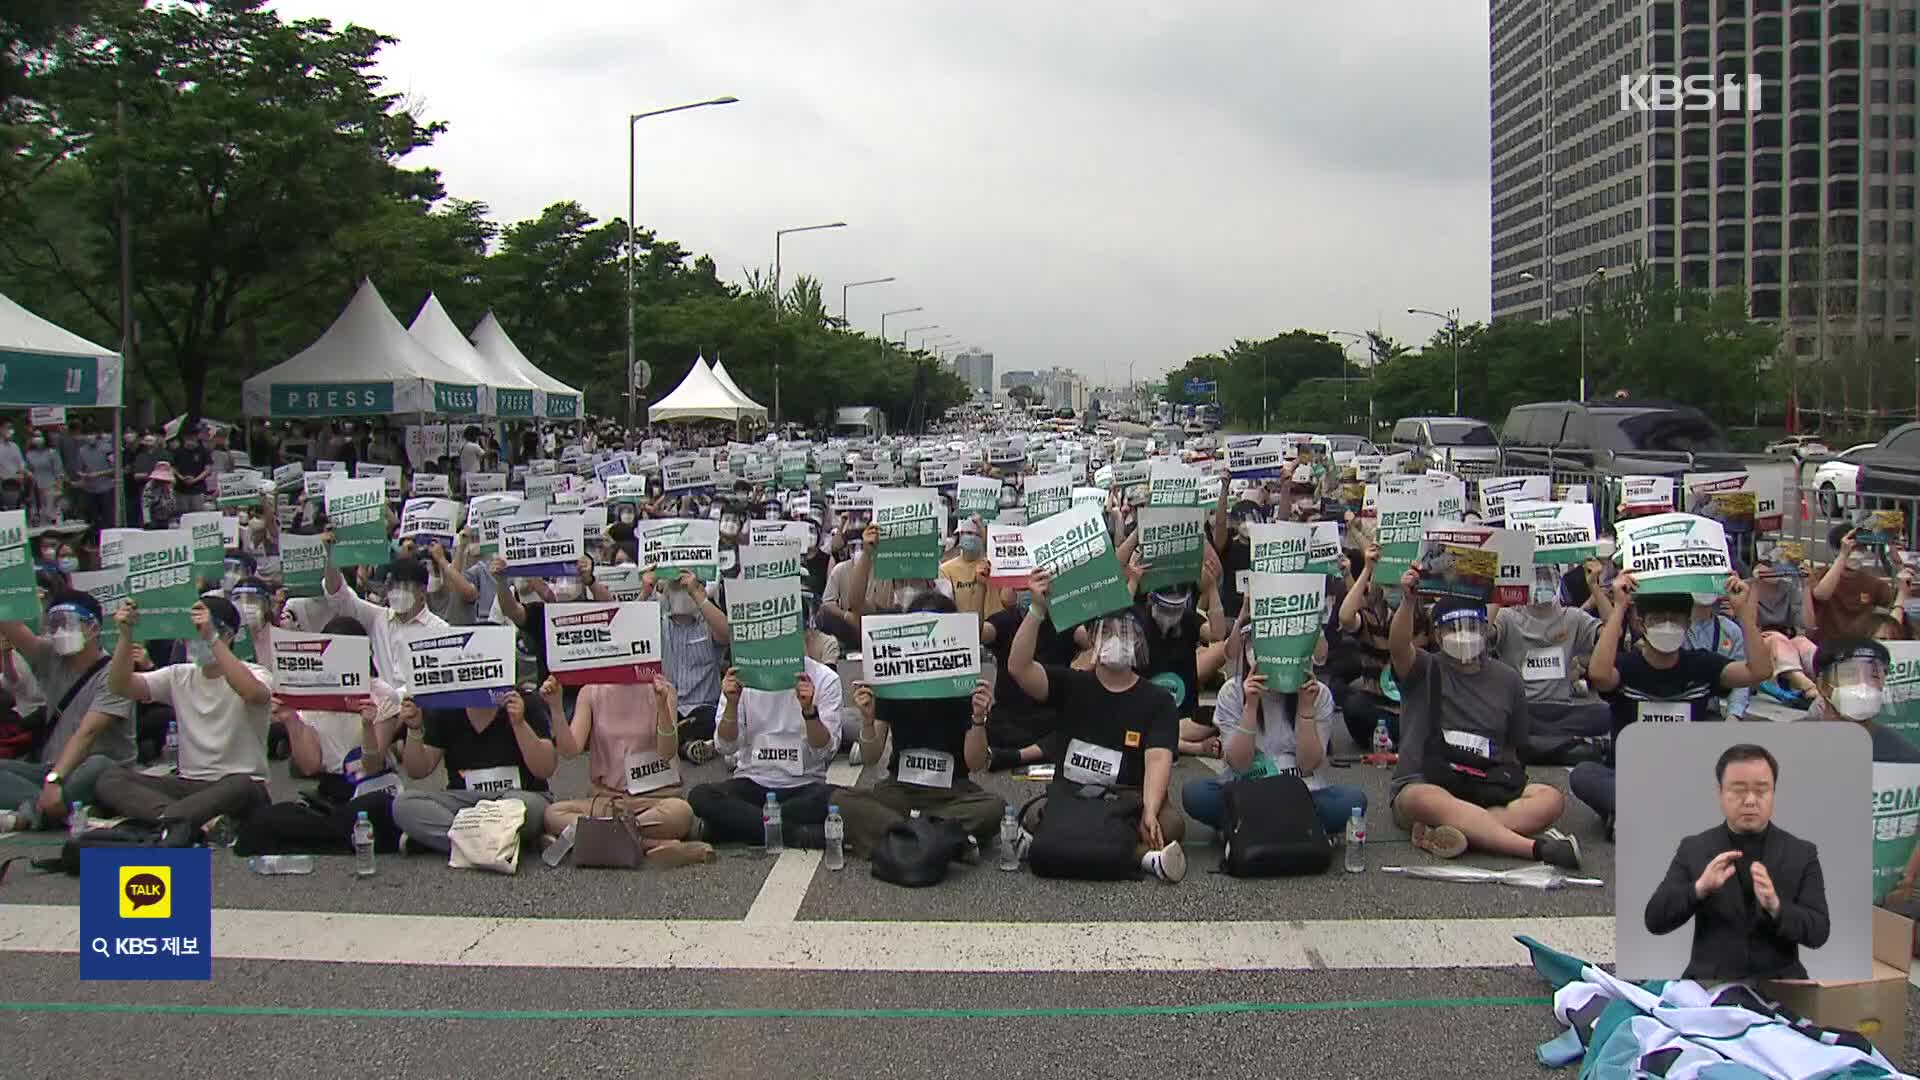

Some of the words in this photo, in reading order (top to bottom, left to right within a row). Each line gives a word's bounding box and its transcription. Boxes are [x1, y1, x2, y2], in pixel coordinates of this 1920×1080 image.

[288, 390, 376, 408] PRESS
[440, 391, 473, 407] PRESS
[501, 395, 529, 411] PRESS
[1152, 478, 1196, 490] 젊은의사
[1151, 489, 1196, 504] 단체행동
[877, 503, 933, 520] 젊은의사
[1143, 521, 1199, 541] 젊은의사
[505, 537, 526, 548] 나는
[644, 540, 661, 552] 나는
[1033, 517, 1100, 563] 젊은의사
[1143, 538, 1200, 559] 단체행동
[1255, 537, 1306, 558] 젊은의사
[505, 548, 537, 560] 의료를
[540, 544, 575, 557] 원한다!
[670, 548, 712, 561] 되고싶다!
[995, 545, 1028, 557] 전공의
[1632, 542, 1660, 557] 나는
[128, 546, 188, 572] 젊은의사
[1254, 555, 1306, 574] 단체행동
[1633, 555, 1672, 572] 의사가
[1675, 553, 1728, 568] 되고싶다!
[743, 558, 796, 580] 젊은의사
[130, 566, 191, 593] 단체행동
[731, 594, 796, 621] 젊은의사
[1255, 592, 1320, 616] 젊은의사
[733, 616, 797, 642] 단체행동
[1255, 614, 1320, 640] 단체행동
[556, 629, 612, 646] 전공의는
[631, 639, 651, 655] 다!
[872, 645, 902, 660] 나는
[277, 656, 323, 672] 전공의는
[412, 655, 439, 670] 나는
[874, 661, 915, 678] 의사가
[916, 653, 973, 673] 되고싶다!
[341, 672, 360, 687] 다!
[414, 669, 454, 687] 의료를
[457, 664, 504, 682] 원한다!
[757, 748, 798, 762] 레지던트
[906, 755, 948, 772] 레지던트
[1071, 752, 1113, 777] 레지던트
